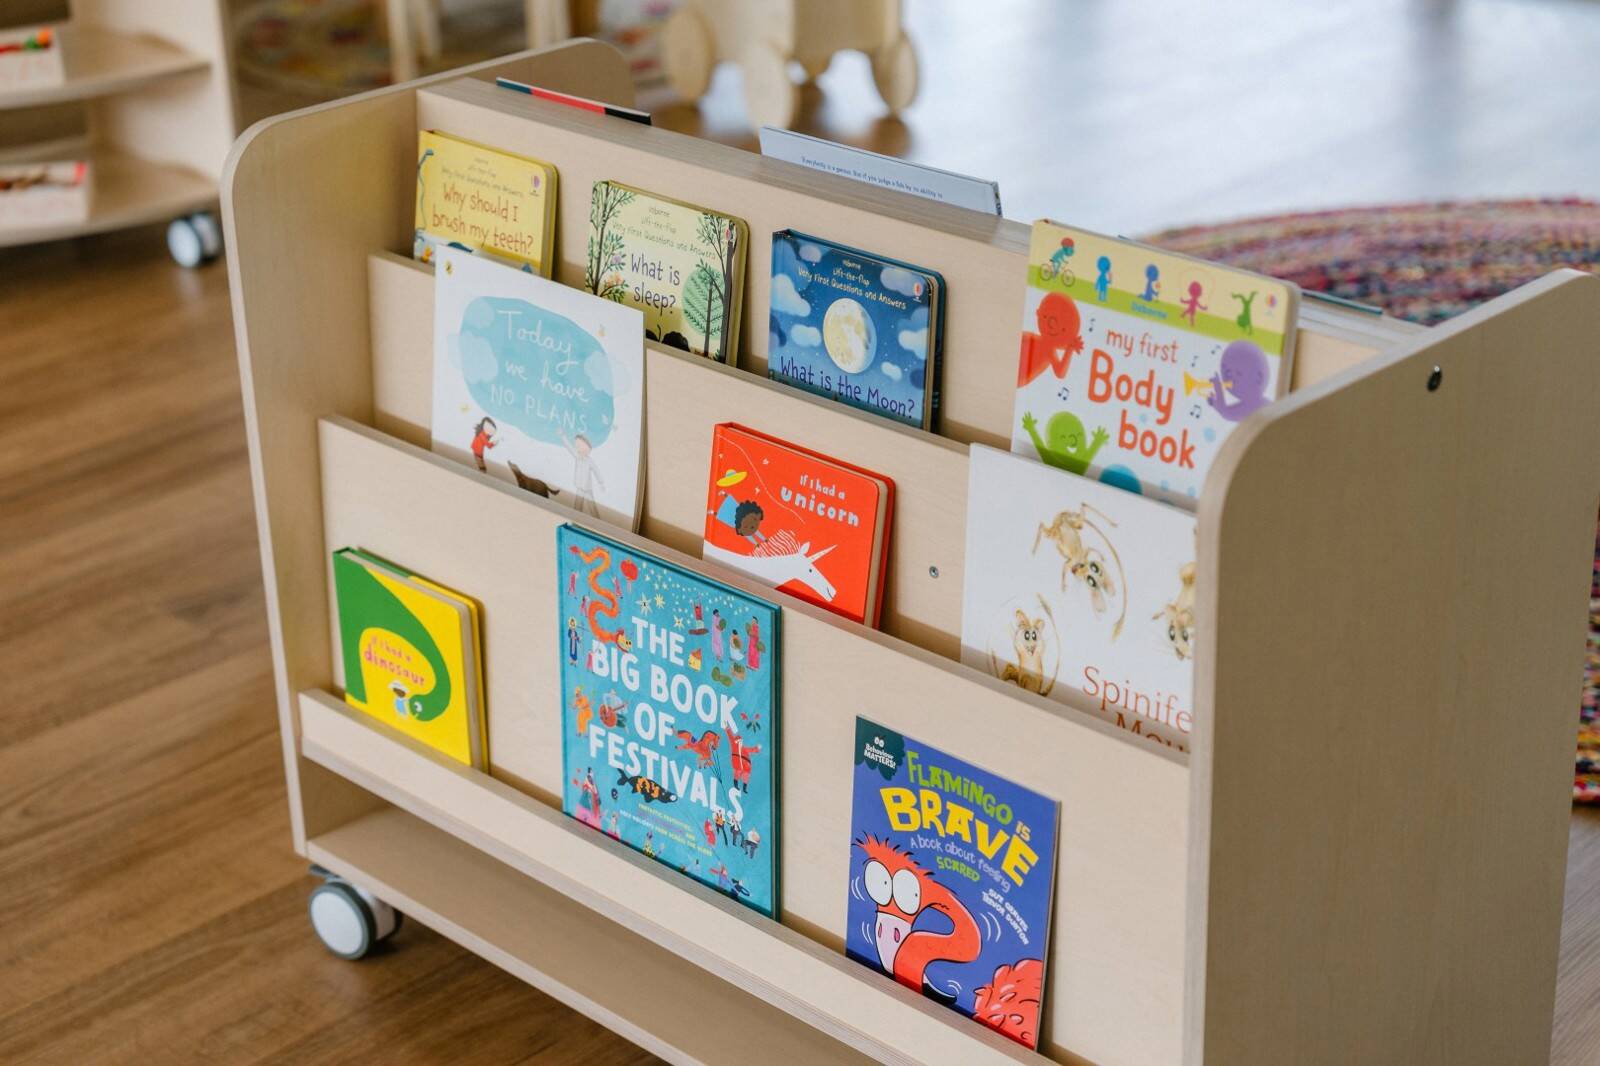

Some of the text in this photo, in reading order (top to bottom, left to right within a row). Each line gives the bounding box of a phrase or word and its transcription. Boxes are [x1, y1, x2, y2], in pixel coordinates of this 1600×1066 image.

[444, 183, 518, 222] Why should I
[432, 203, 534, 255] brush my teeth?
[631, 253, 680, 286] What is
[798, 265, 906, 310] Very First Questions and Answers
[634, 282, 676, 316] sleep?
[497, 310, 579, 375] Today
[1106, 329, 1179, 364] my first
[505, 359, 590, 403] we have
[780, 356, 914, 419] What is the Moon?
[1088, 348, 1174, 425] Body
[491, 384, 588, 433] NO PLANS
[1118, 408, 1196, 470] book
[780, 486, 859, 527] unicorn
[816, 478, 836, 496] had
[838, 492, 845, 500] a
[631, 616, 686, 667] THE
[364, 643, 424, 686] dinosaur
[592, 640, 739, 734] BIG BOOK
[634, 702, 675, 746] OF
[589, 724, 744, 823] FESTIVALS
[864, 749, 896, 770] MATTERS!
[866, 743, 894, 760] Behaviour
[880, 788, 1039, 887] BRAVE
[910, 834, 1011, 893] A book about feeling
[936, 856, 980, 882] SCARED
[982, 890, 1030, 945] TREVOR DUNTON
[988, 888, 1029, 932] SUE GRAVES
